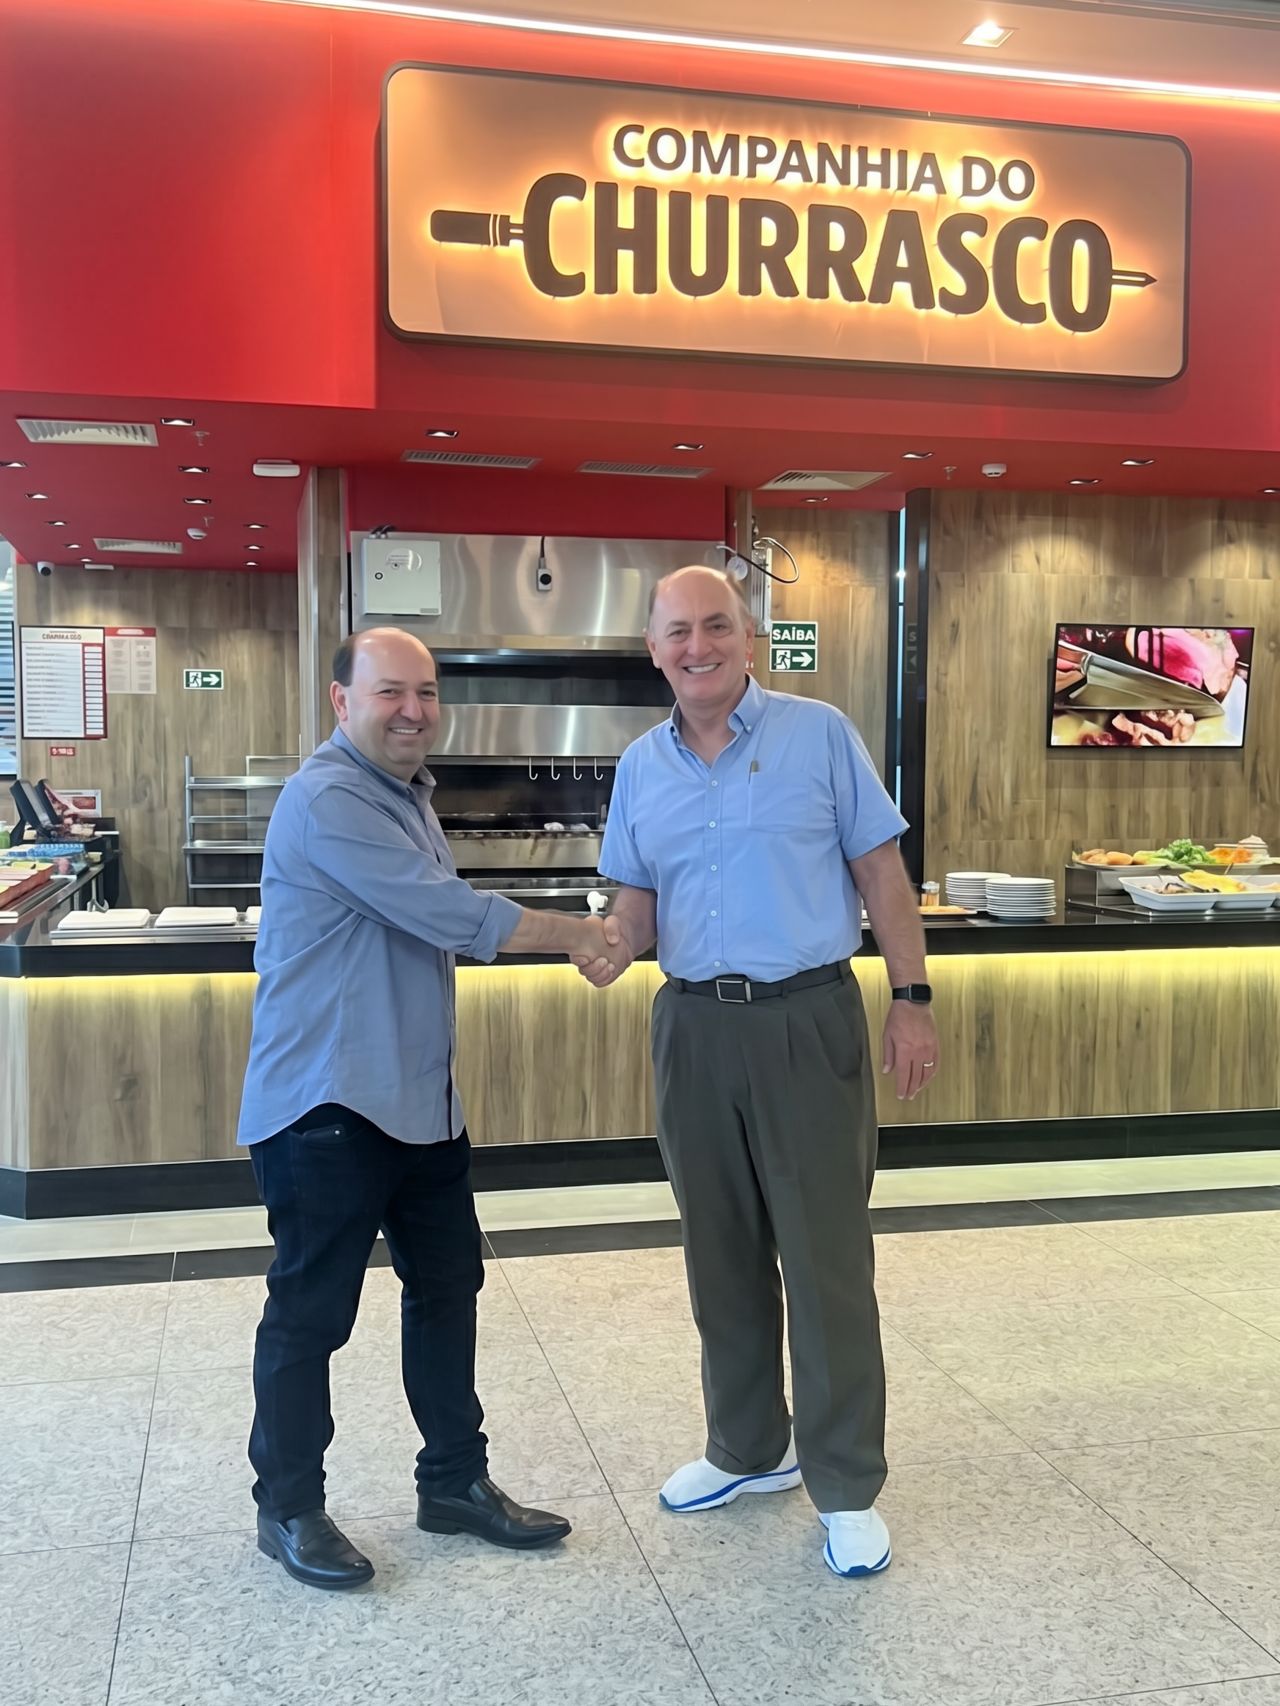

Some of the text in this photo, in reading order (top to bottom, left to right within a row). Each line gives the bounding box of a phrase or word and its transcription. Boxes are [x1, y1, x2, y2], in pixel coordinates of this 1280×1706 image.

[613, 124, 1036, 201] COMPANHIA DO
[522, 172, 1113, 334] CHURRASCO
